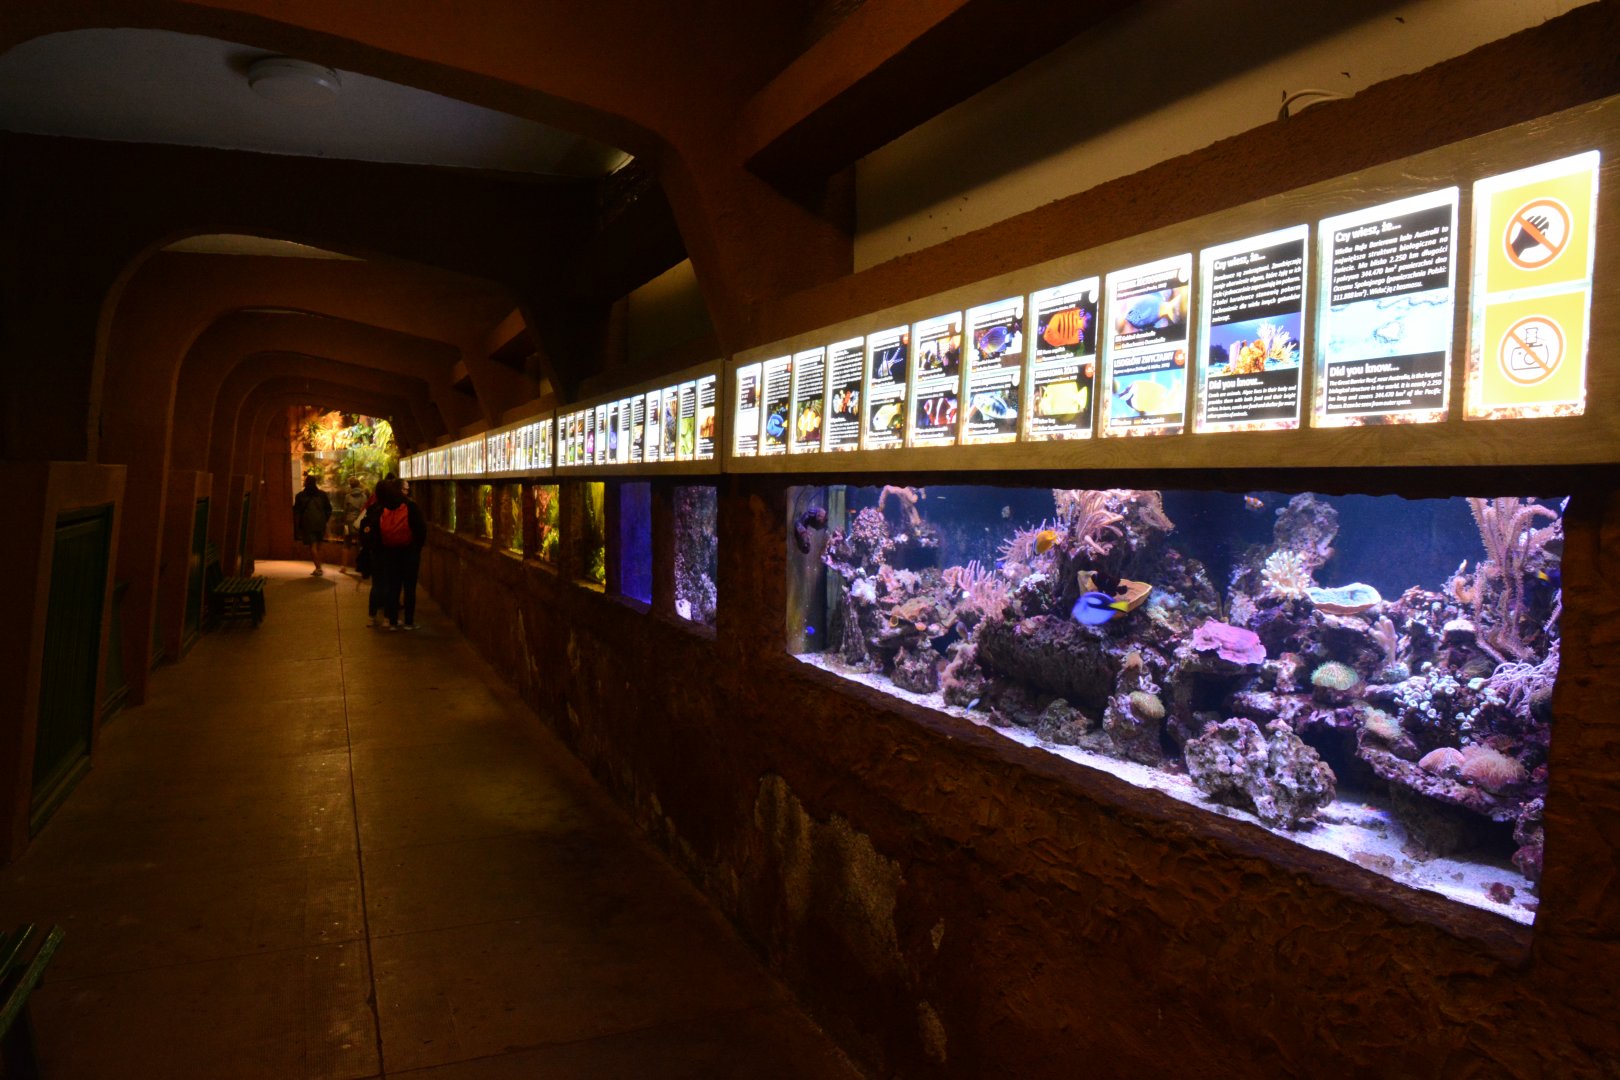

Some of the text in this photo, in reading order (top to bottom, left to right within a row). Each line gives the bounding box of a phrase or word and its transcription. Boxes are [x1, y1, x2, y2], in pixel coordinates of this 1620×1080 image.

[1335, 222, 1401, 242] Czy wiesz, że...
[1414, 227, 1439, 238] Australii
[1368, 247, 1397, 257] struktura
[1399, 239, 1436, 251] biologiczna
[1370, 258, 1387, 266] blisko
[1389, 254, 1407, 263] 2.250
[1421, 245, 1448, 256] długości
[1330, 363, 1399, 377] Did you know...
[1209, 378, 1263, 390] Did you know...
